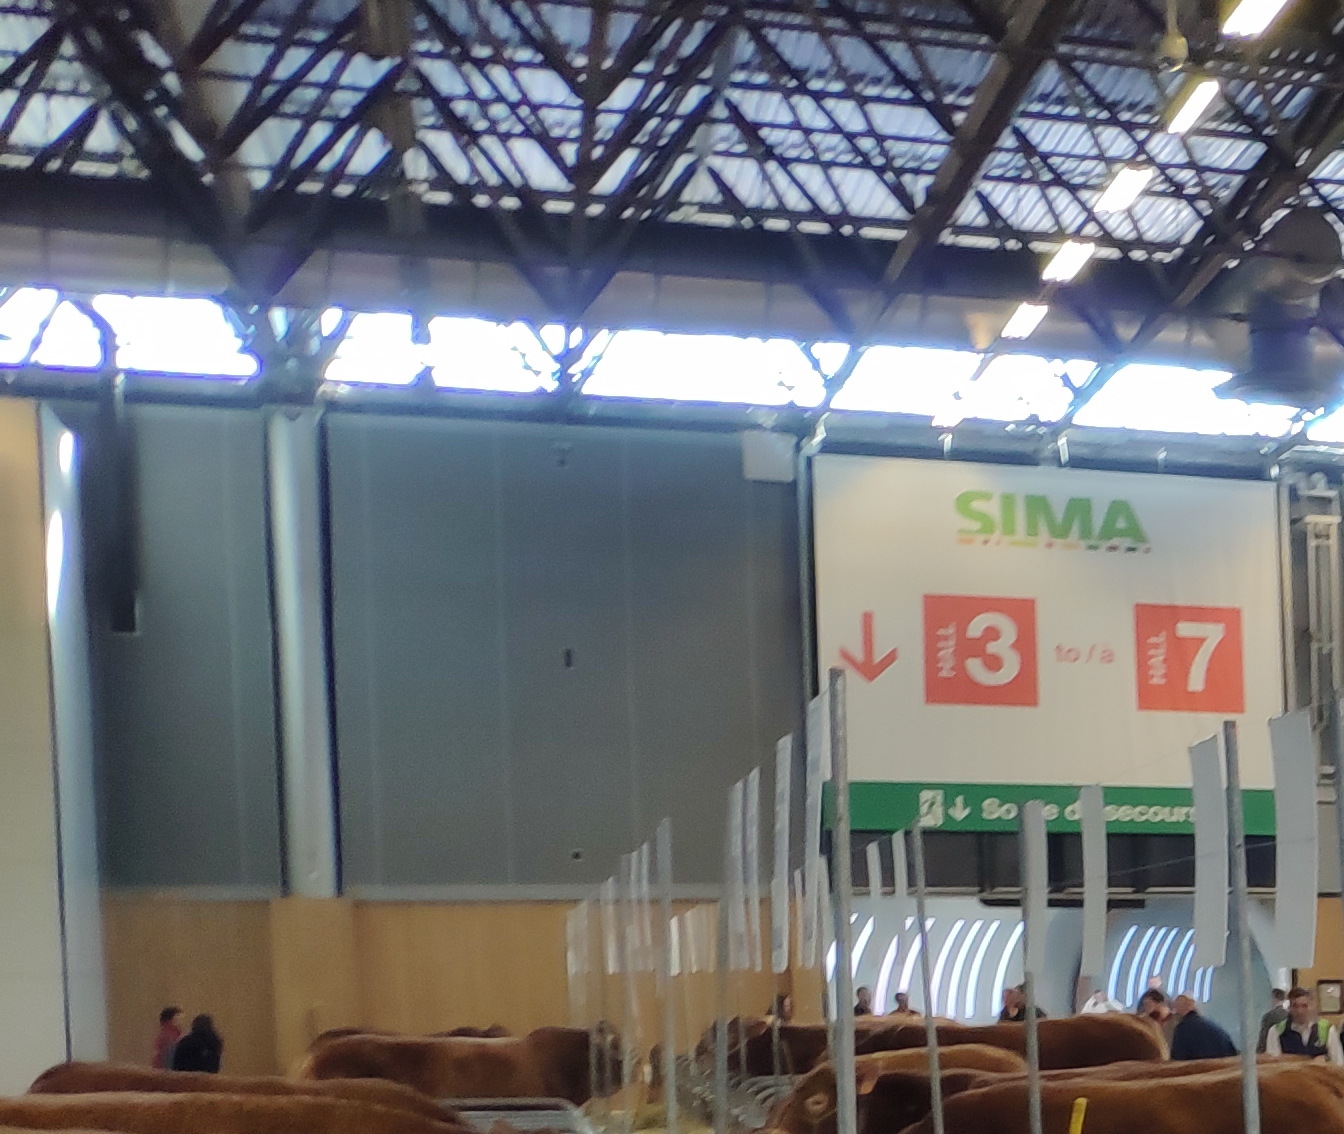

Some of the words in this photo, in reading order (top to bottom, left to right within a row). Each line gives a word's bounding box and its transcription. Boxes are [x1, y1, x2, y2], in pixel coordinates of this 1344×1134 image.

[955, 491, 1147, 542] SIMA
[936, 621, 957, 679] HALL
[966, 611, 1021, 686] 3
[1146, 630, 1168, 685] HALL
[1175, 621, 1226, 692] 7
[981, 797, 1059, 820] Soe
[1103, 804, 1195, 822] secour
